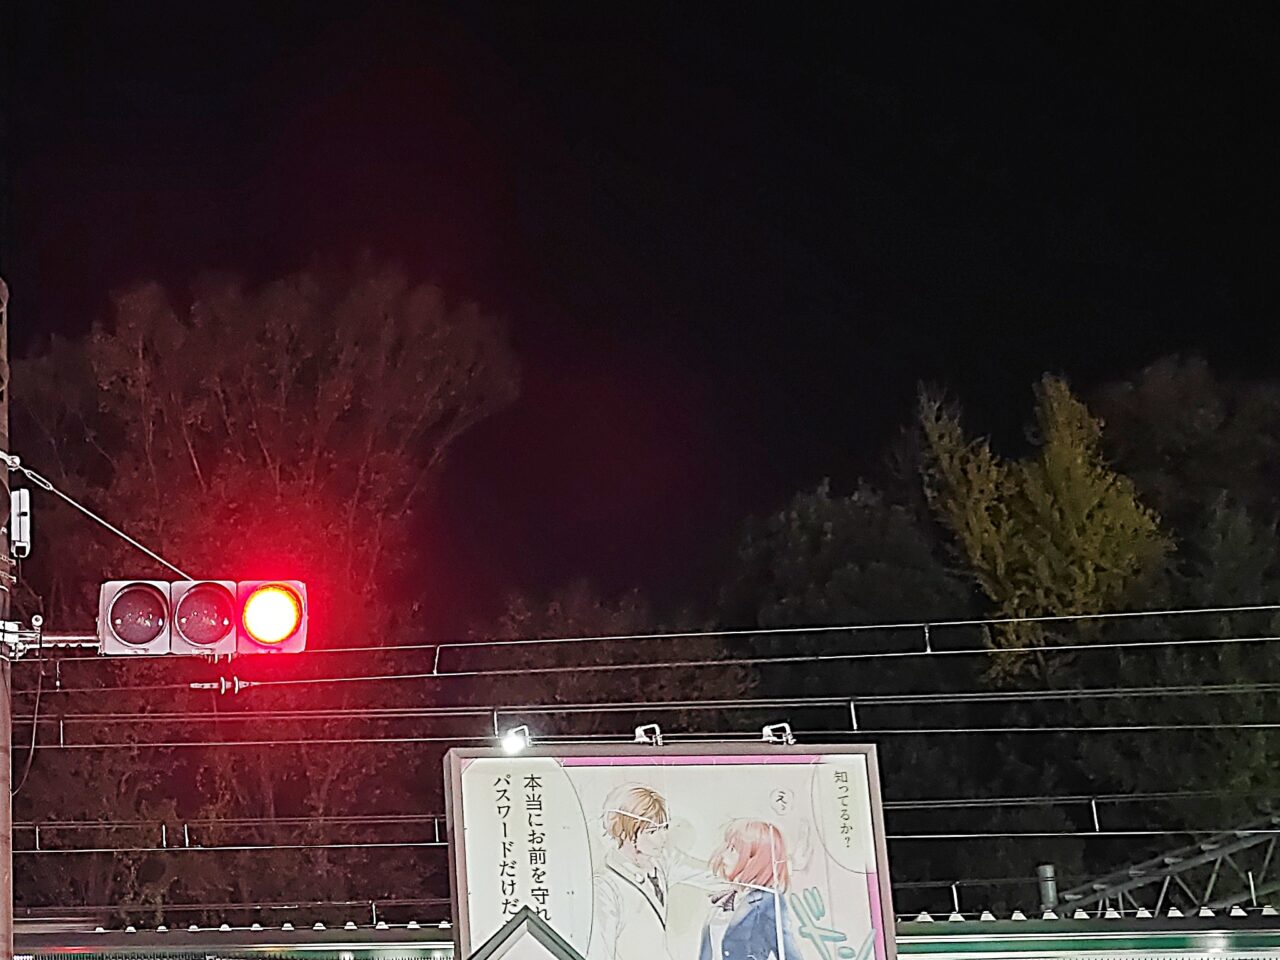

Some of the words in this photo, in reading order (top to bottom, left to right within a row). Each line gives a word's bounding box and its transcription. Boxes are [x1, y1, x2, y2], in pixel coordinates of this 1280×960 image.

[493, 773, 519, 927] パスワードだけだ
